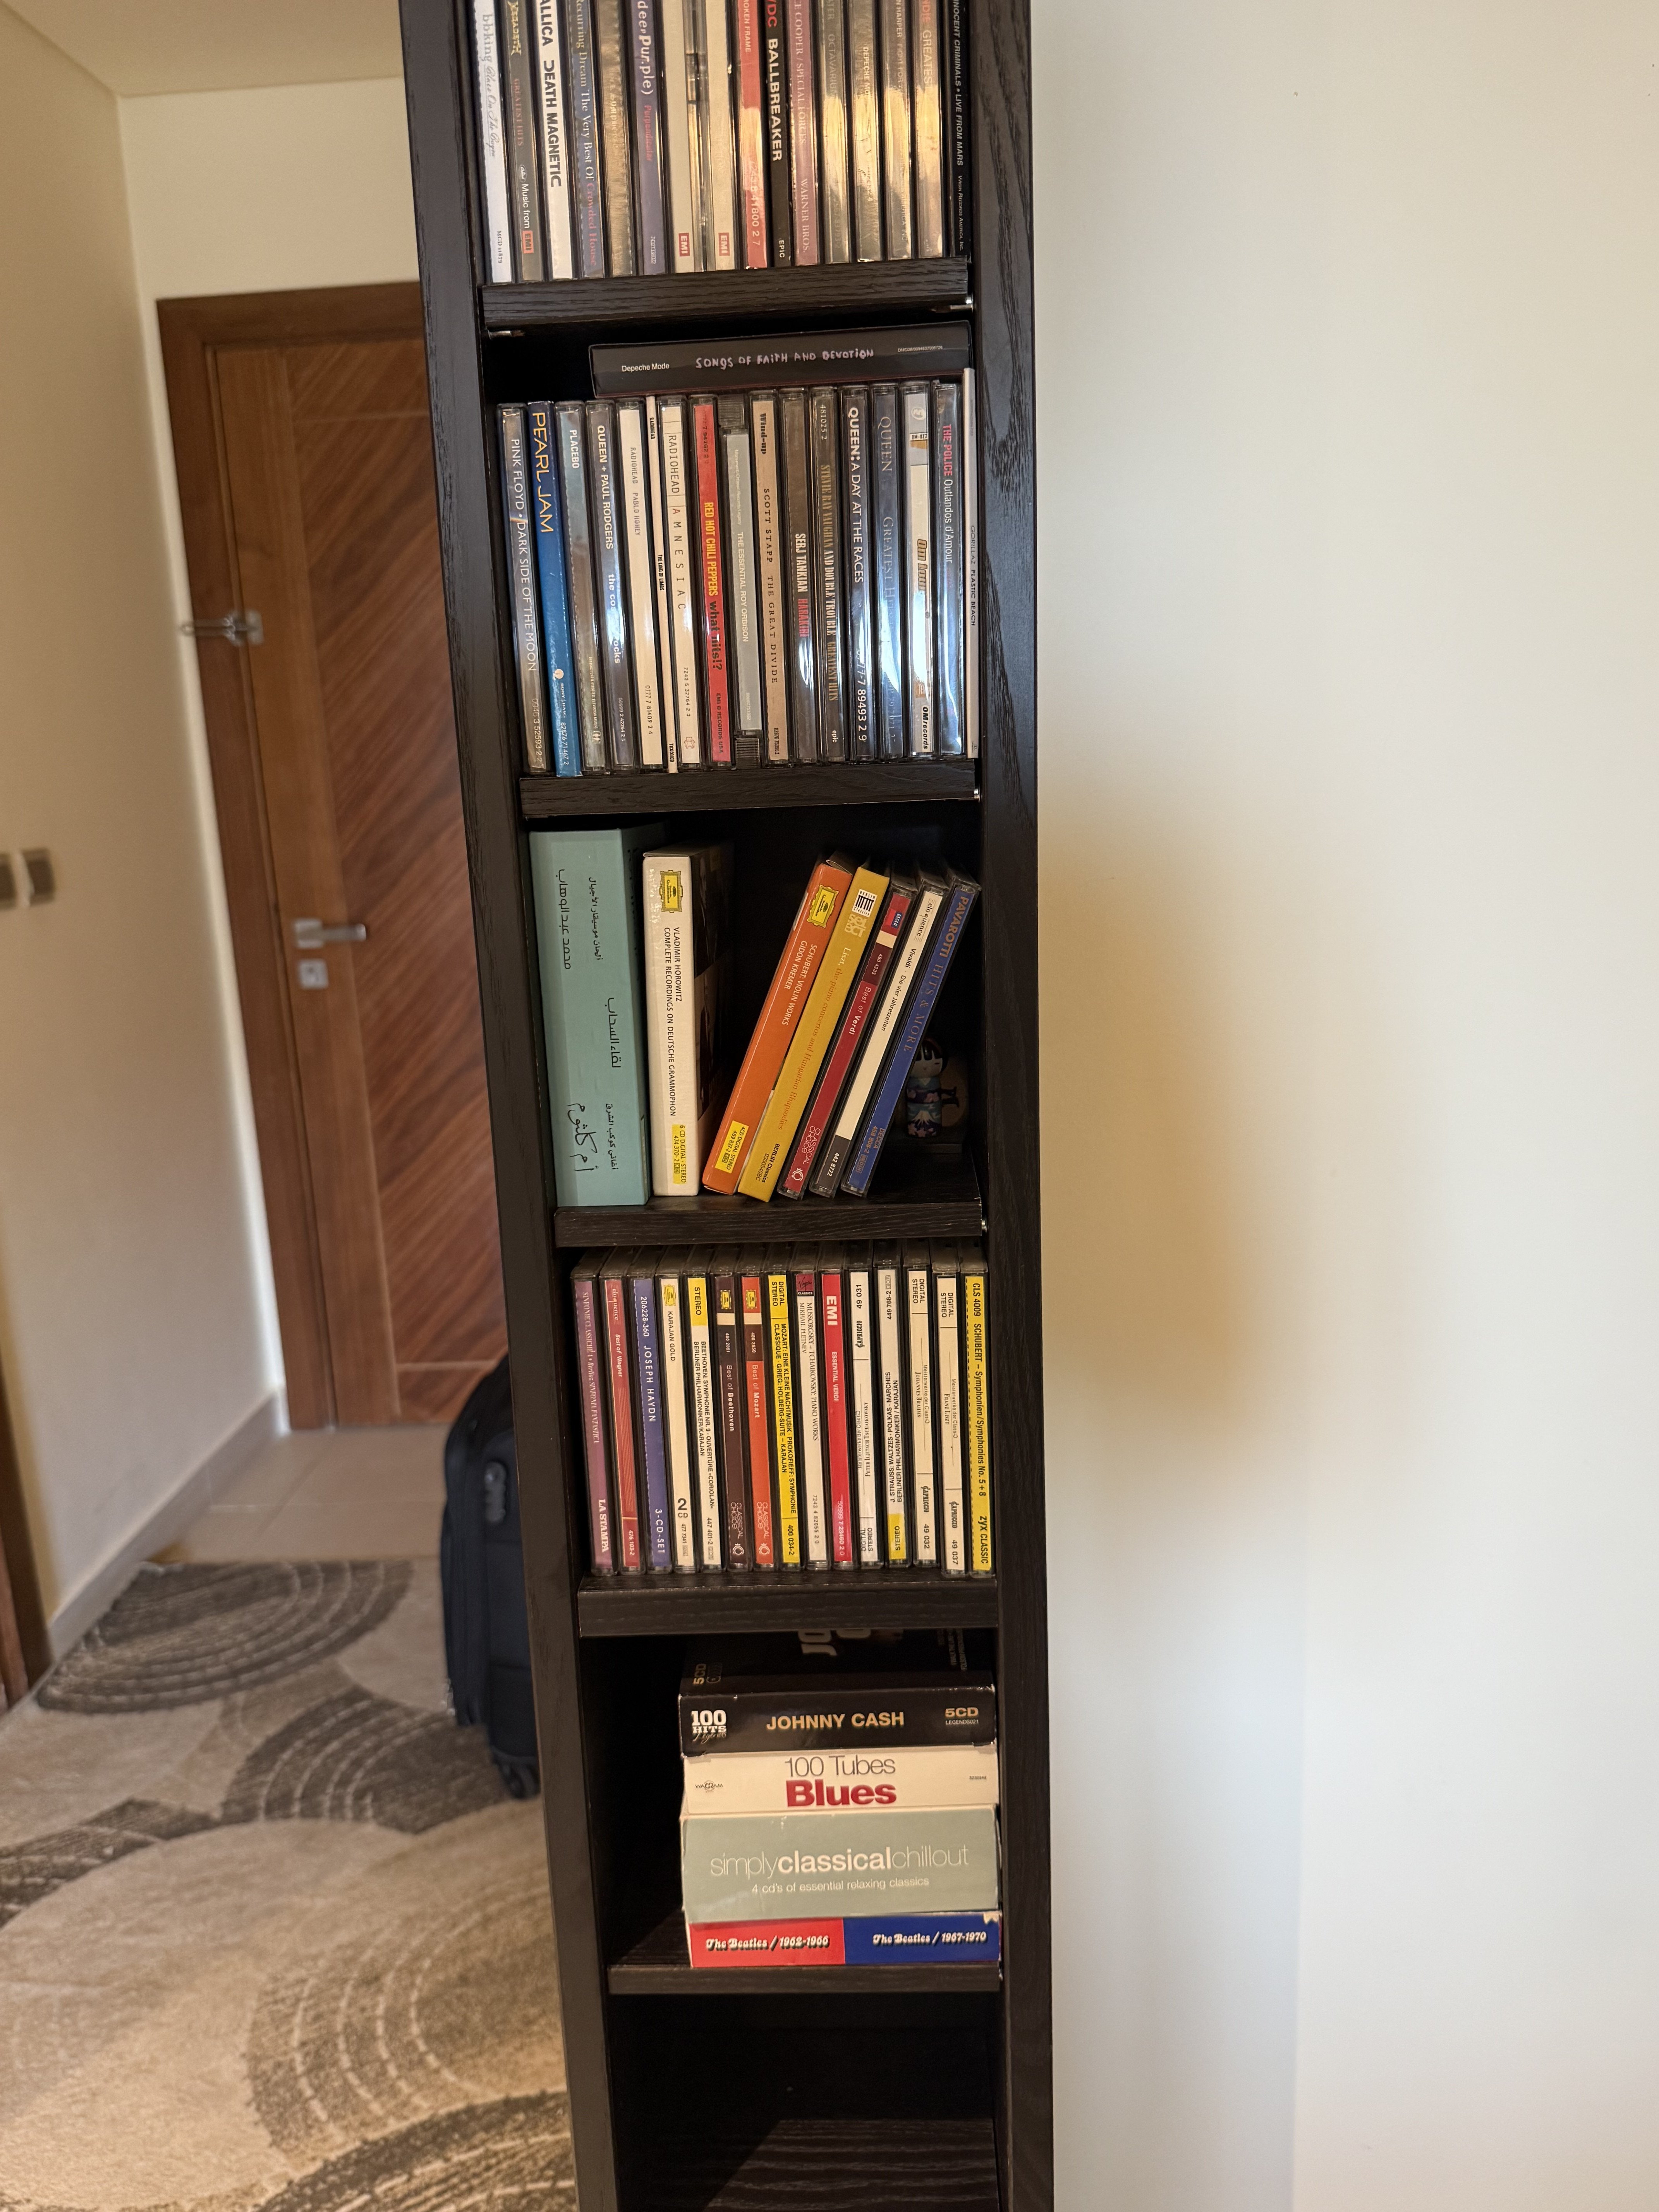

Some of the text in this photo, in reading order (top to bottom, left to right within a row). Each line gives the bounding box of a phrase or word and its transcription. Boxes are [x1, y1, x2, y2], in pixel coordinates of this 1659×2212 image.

[768, 38, 782, 161] BALLBREAKER
[794, 12, 810, 222] COOPER WARNER
[543, 60, 562, 187] DEATH MAGNETIC
[579, 52, 598, 266] Dream The Very Best Of Crowded House
[522, 184, 533, 251] Music from EMI
[680, 235, 689, 254] EMI
[720, 235, 729, 254] EMI
[739, 356, 751, 365] OF
[794, 351, 816, 362] AND
[570, 430, 579, 468] PLACEBO
[597, 425, 607, 463] QUEEN
[760, 413, 768, 455] Wind-up
[877, 416, 892, 472] QUEEN
[532, 413, 554, 532] PEARL JAM
[630, 447, 638, 484] RADIOHEAD
[668, 435, 680, 493] RADIOHEAD
[601, 475, 610, 500] PAUL
[943, 424, 954, 563] THE POLICE Outlandos d'Amour
[603, 502, 613, 550] RODGERS
[795, 533, 807, 553] SERJ
[511, 439, 536, 671] PINK FLOYD DARK SIDE OF THE MOON
[704, 502, 719, 631] RED HOT CHILI PEPPERS what
[738, 549, 746, 589] ESSENTIAL
[796, 555, 808, 592] TANKIAN
[849, 407, 866, 721] QUEEN: A DAY AT THE RACES 89493
[784, 941, 807, 990] GIDON KREMER
[903, 896, 969, 1052] PAVAROTTI MORE
[904, 948, 917, 968] Vivaldi
[782, 945, 817, 1026] SCHUBERT: VIOLIN WORKS
[667, 1013, 674, 1024] ON
[778, 947, 852, 1130] Liszt, Rhapsodies
[849, 1015, 861, 1036] Verdi
[606, 1103, 615, 1147] كوكب الشرق
[826, 1295, 838, 1326] EMI
[641, 1296, 665, 1554] 206228-360 JOSEPH HAYDN 3-CD-SET
[974, 1324, 982, 1362] SCHUBERT
[980, 1533, 988, 1564] CLASSIC
[599, 1499, 609, 1553] LA STAMPA
[691, 1710, 726, 1726] 100
[766, 1712, 904, 1731] JOHNNY CASH
[945, 1707, 979, 1717] 5CD
[785, 1755, 896, 1778] 100 Tubes
[786, 1779, 897, 1807] Blues
[752, 1877, 929, 1894] 4 cd's of essential relaxing classics
[706, 1936, 829, 1950] The Beatles 1962-1966
[872, 1932, 986, 1945] The Beatles 1967-1970
